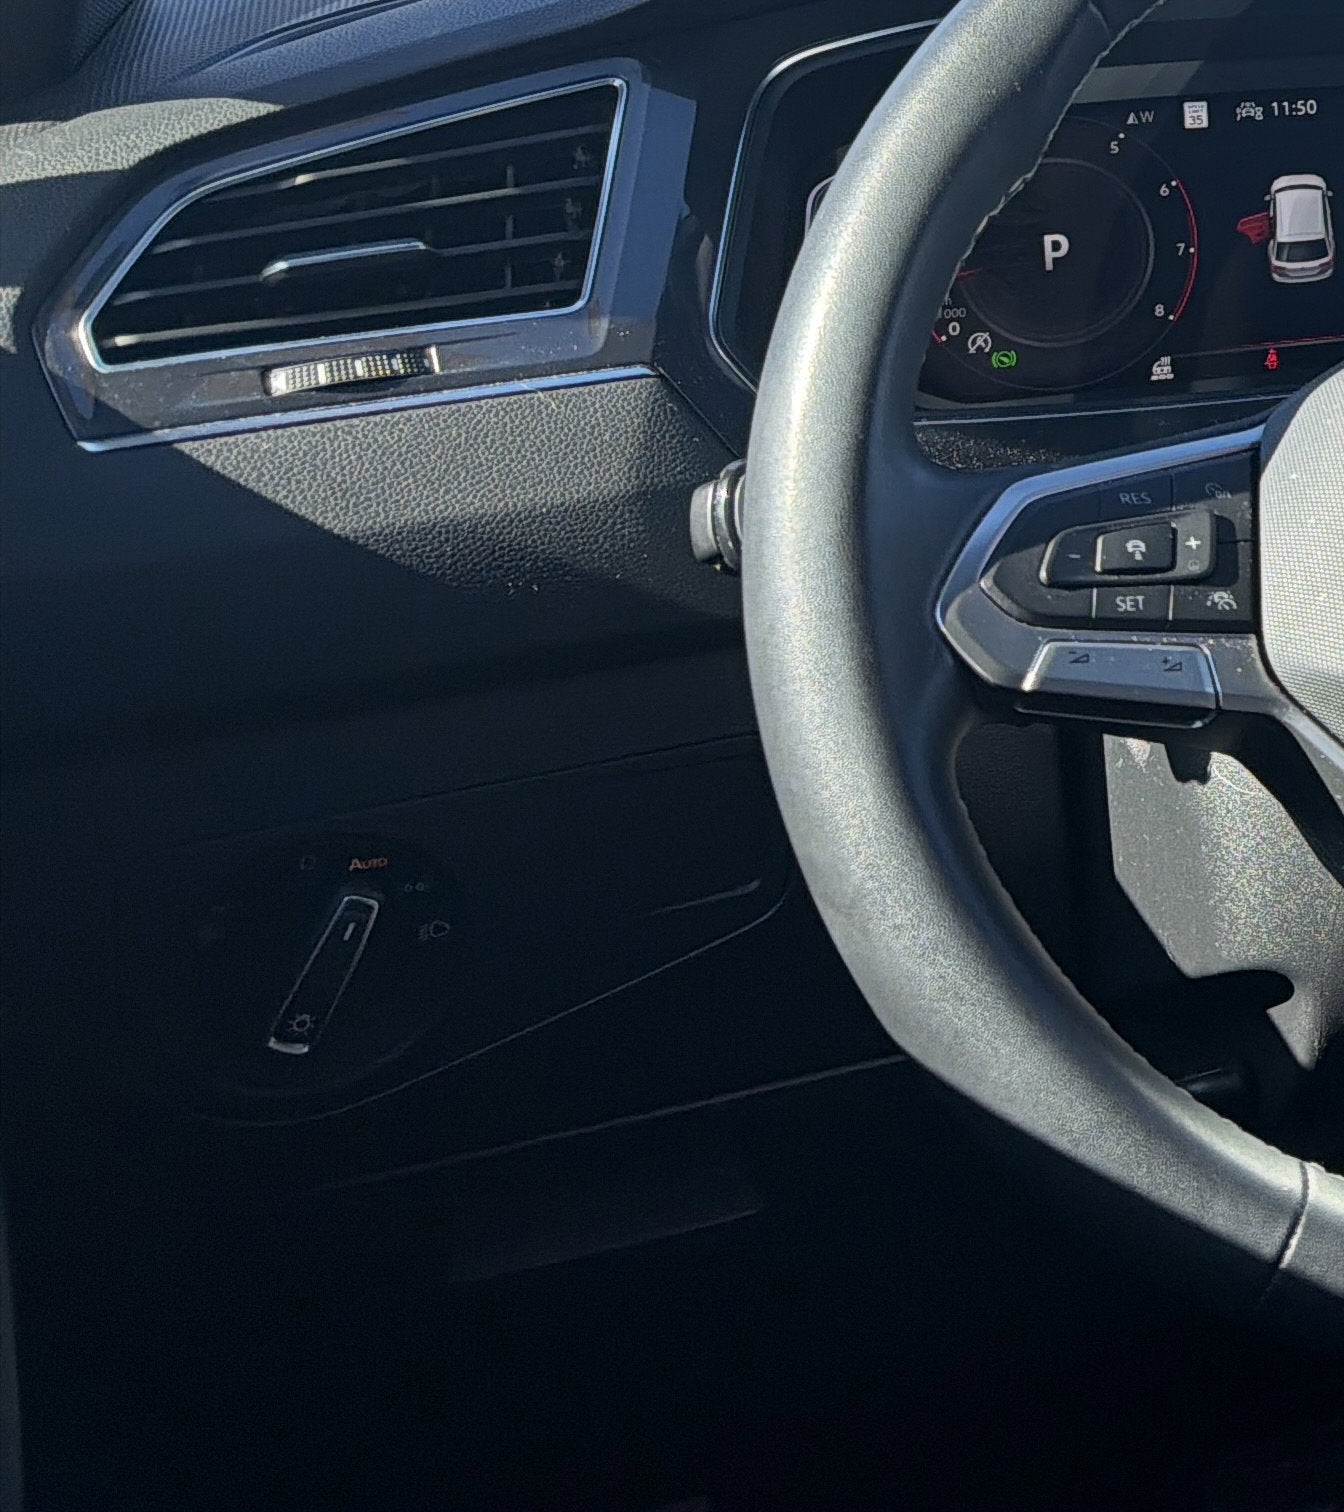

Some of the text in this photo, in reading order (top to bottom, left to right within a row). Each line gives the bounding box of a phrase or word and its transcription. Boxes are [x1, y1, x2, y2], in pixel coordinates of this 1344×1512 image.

[1271, 99, 1317, 116] 11:50
[1139, 110, 1154, 123] W
[1189, 114, 1204, 126] 35
[1109, 141, 1120, 154] 5
[1159, 184, 1170, 197] 6
[1042, 233, 1070, 271] P
[1176, 243, 1185, 256] 7
[1154, 304, 1165, 317] 8
[949, 322, 960, 335] 0
[1119, 492, 1151, 505] RES
[1116, 595, 1145, 612] SET
